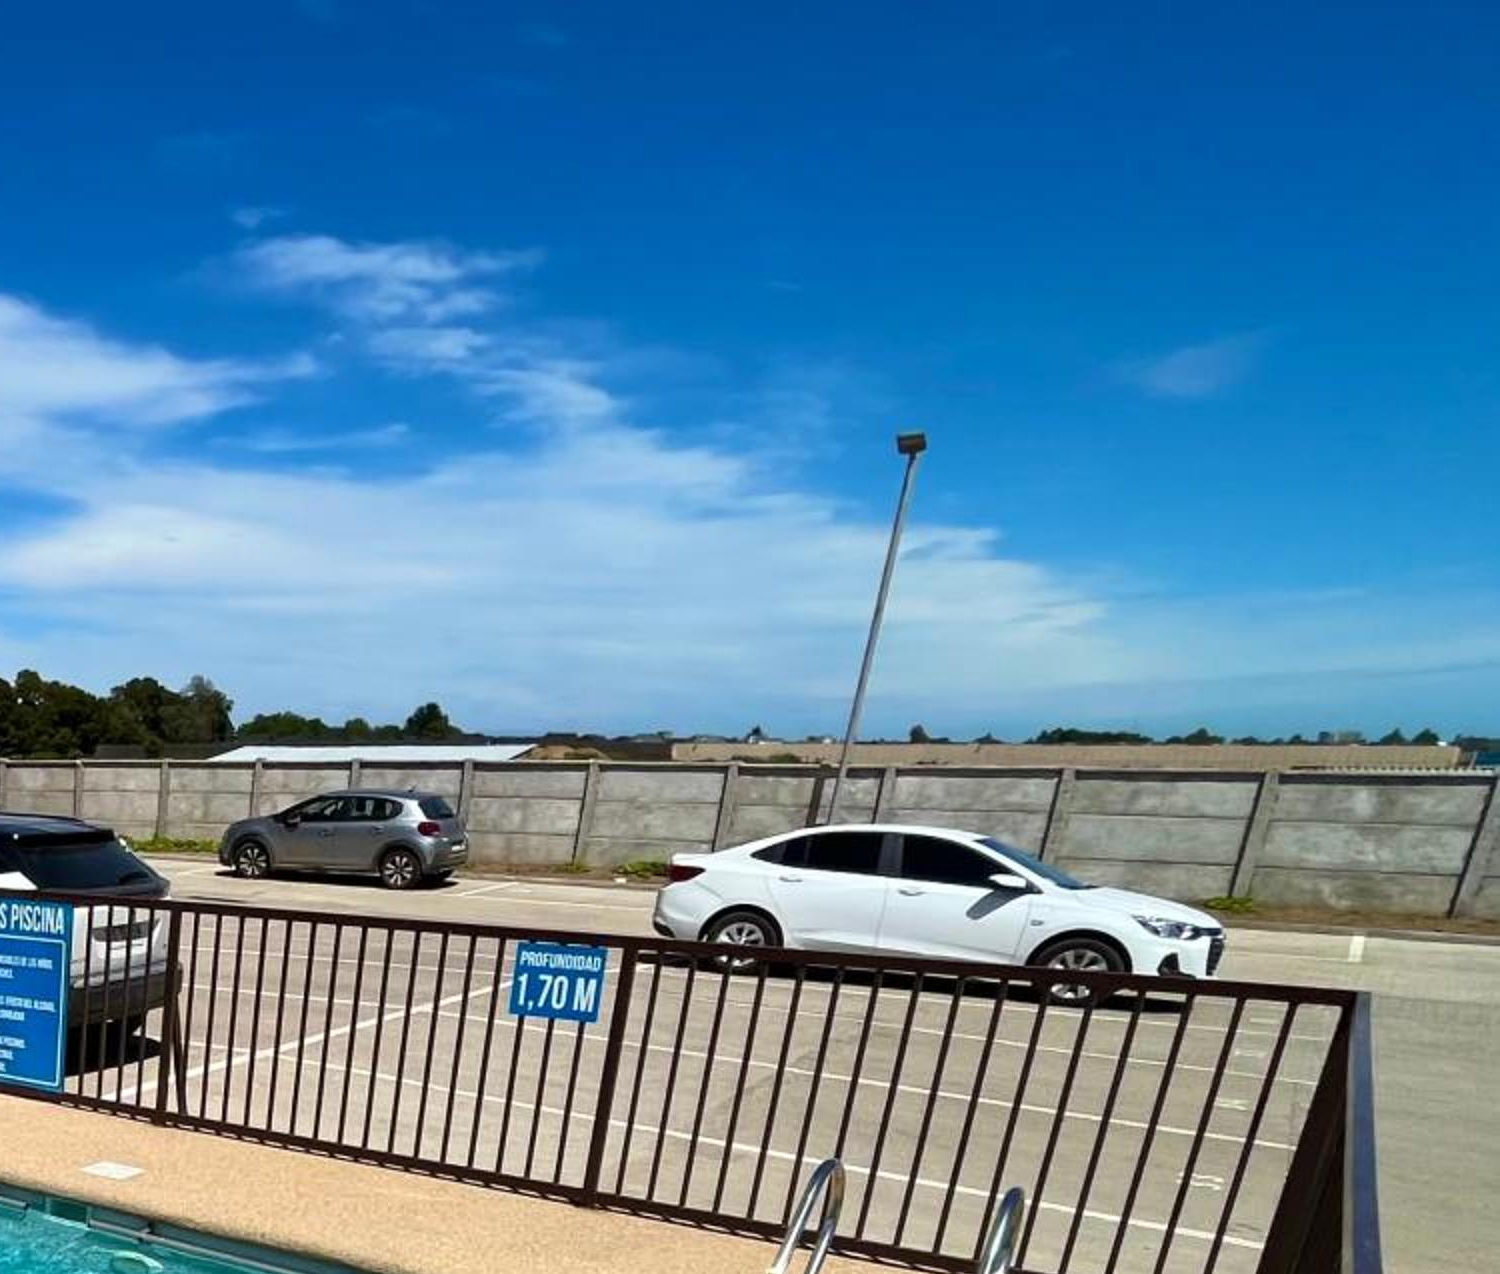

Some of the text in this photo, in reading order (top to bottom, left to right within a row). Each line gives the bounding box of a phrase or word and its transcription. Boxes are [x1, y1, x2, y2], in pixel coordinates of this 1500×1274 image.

[10, 903, 65, 935] PISCINA
[519, 950, 603, 973] PROFUNDIDAD
[517, 972, 597, 1012] 1,70 M
